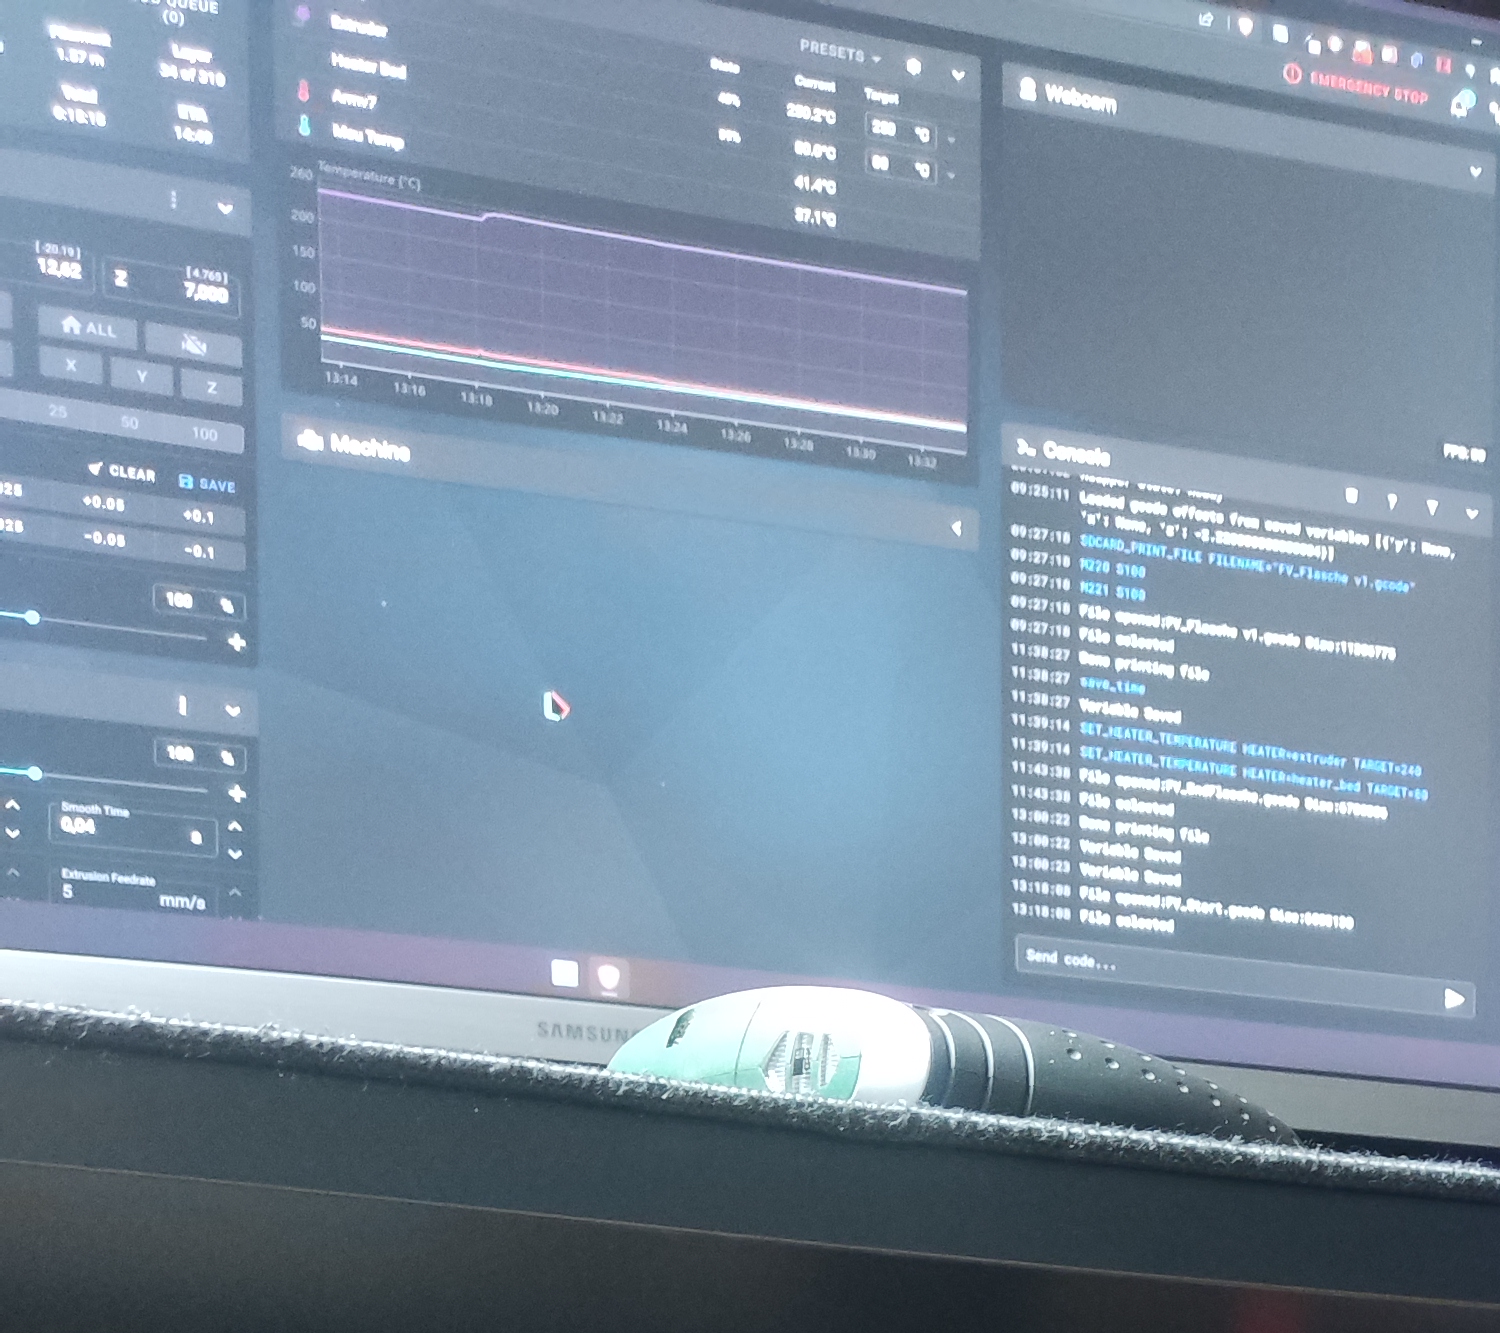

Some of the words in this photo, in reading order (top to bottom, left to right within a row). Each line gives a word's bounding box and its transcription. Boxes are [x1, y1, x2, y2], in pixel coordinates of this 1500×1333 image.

[800, 38, 865, 63] PRESETS
[1310, 71, 1390, 98] EMERGENCY
[1394, 87, 1429, 105] STOP
[294, 280, 316, 294] 100
[86, 322, 117, 338] ALL
[301, 316, 317, 330] 50
[66, 358, 77, 372] X
[136, 369, 147, 383] Y
[207, 381, 218, 395] Z
[49, 404, 67, 418] 25
[121, 416, 139, 430] 50
[193, 426, 218, 441] 100
[109, 464, 156, 484] CLEAR
[200, 478, 236, 494] SAVE
[61, 800, 102, 816] Smooth
[105, 804, 131, 818] Time
[61, 867, 110, 883] Extrusion
[111, 871, 156, 888] Feedrate
[62, 883, 73, 899] 5
[159, 893, 207, 910] mm/s
[1026, 948, 1059, 964] Send
[1064, 952, 1117, 972] code...
[537, 1020, 637, 1042] SAMSUN
